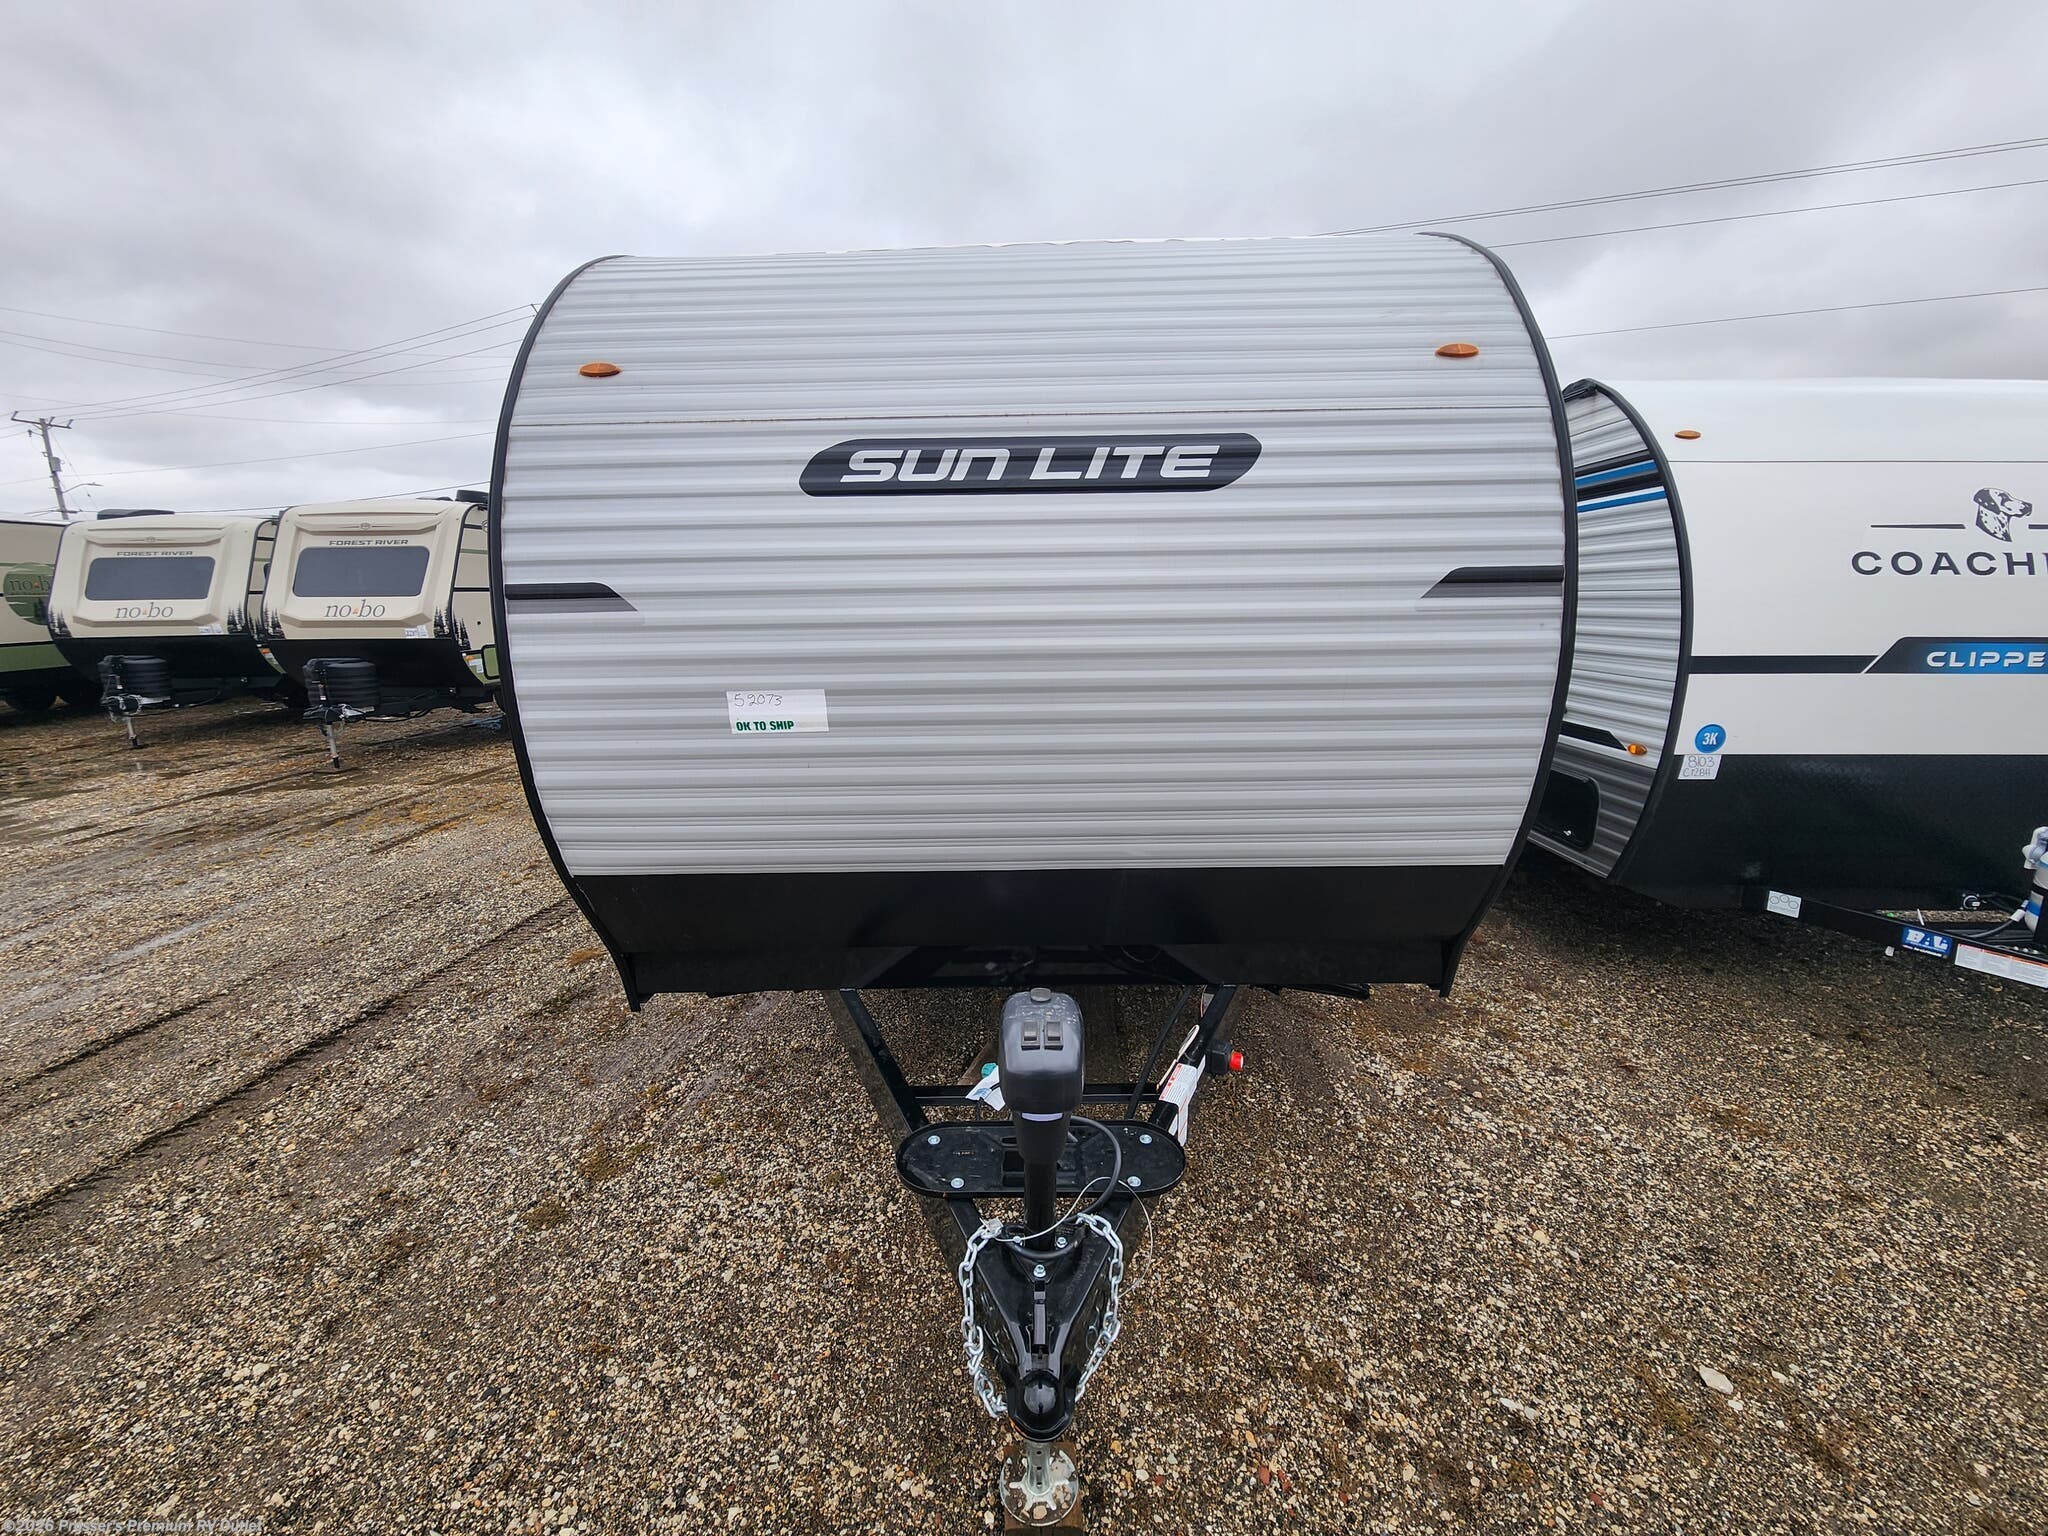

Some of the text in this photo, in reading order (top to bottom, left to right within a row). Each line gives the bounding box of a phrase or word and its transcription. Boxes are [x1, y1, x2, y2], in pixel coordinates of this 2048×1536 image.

[840, 445, 1220, 482] SUN LITE
[1851, 551, 2048, 576] COACH
[735, 720, 794, 731] OK TO SHIP
[1702, 732, 1719, 746] 3K
